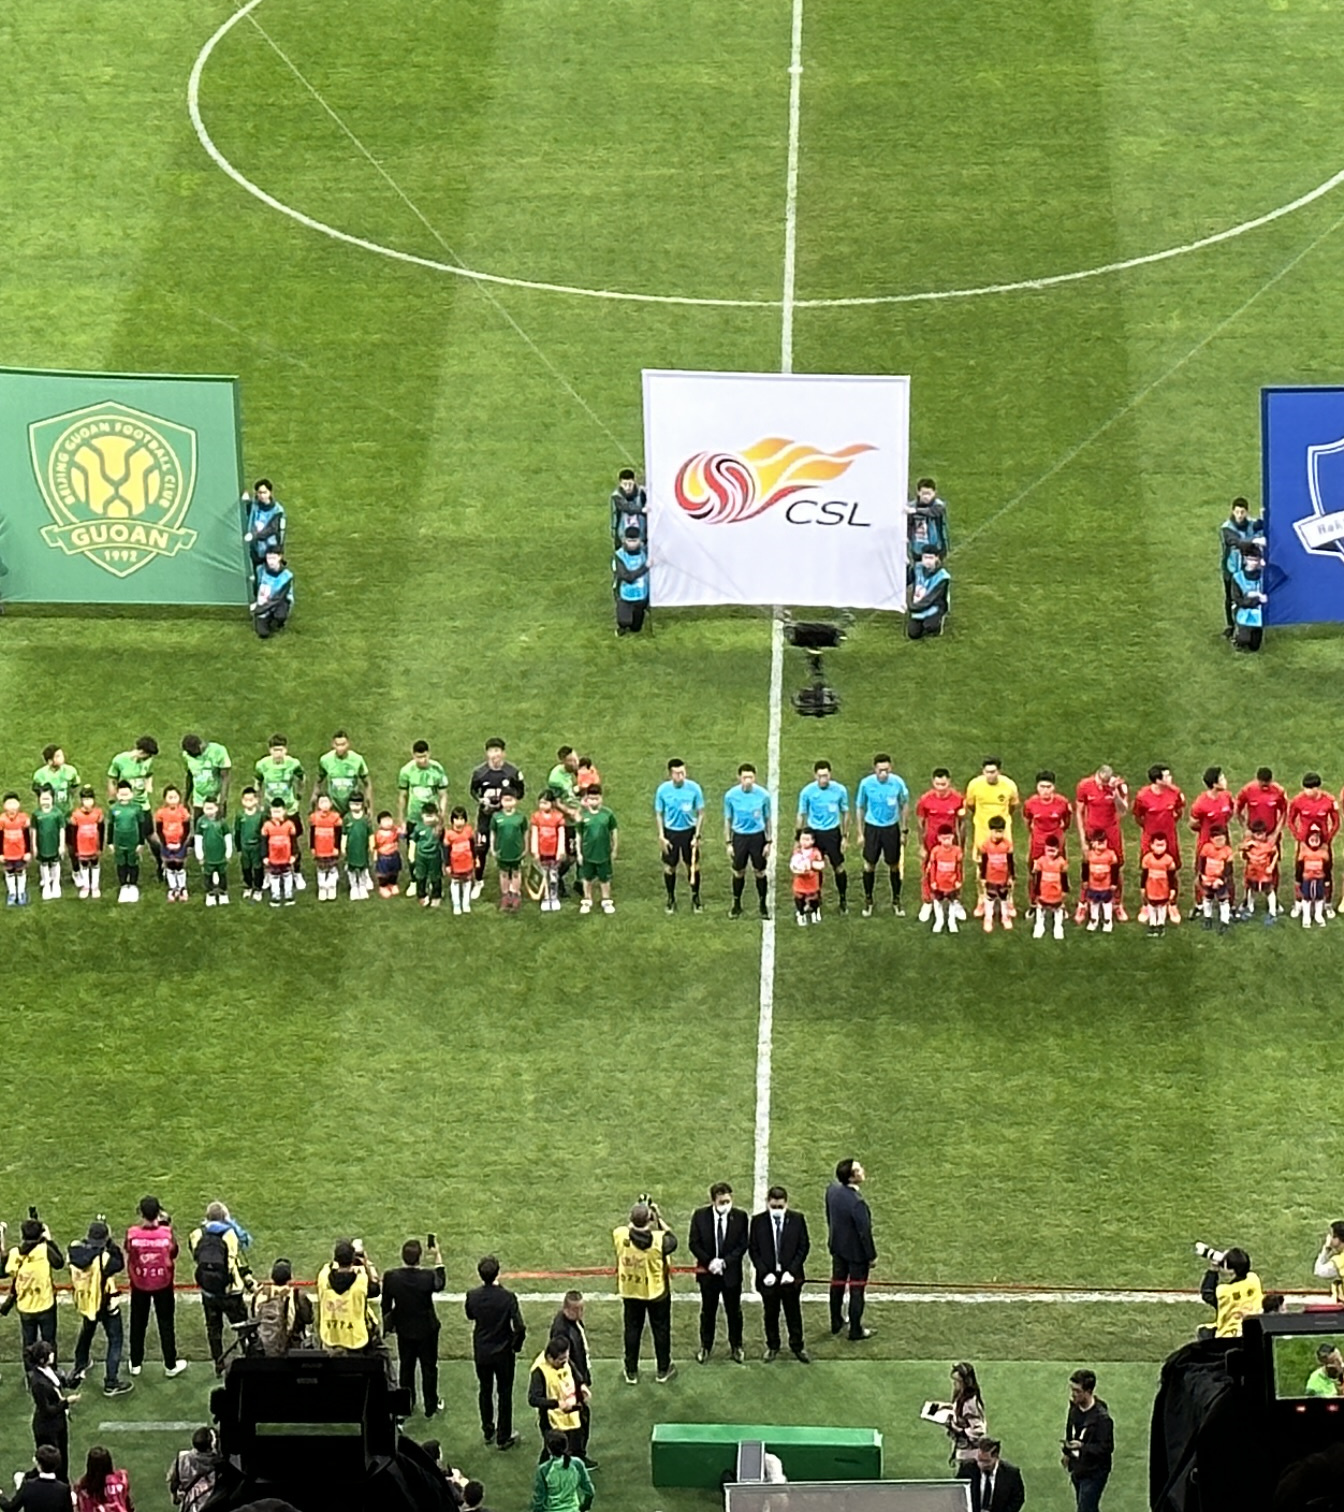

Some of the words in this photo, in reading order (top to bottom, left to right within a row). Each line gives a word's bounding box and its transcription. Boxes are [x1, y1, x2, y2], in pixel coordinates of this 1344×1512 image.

[65, 423, 111, 452] GUOAN
[114, 422, 173, 472] FOOTBALL
[55, 452, 76, 506] BEIJING
[158, 473, 178, 508] CLUB
[785, 499, 872, 527] CSL
[71, 525, 170, 549] GUOAN
[104, 550, 138, 562] 1992
